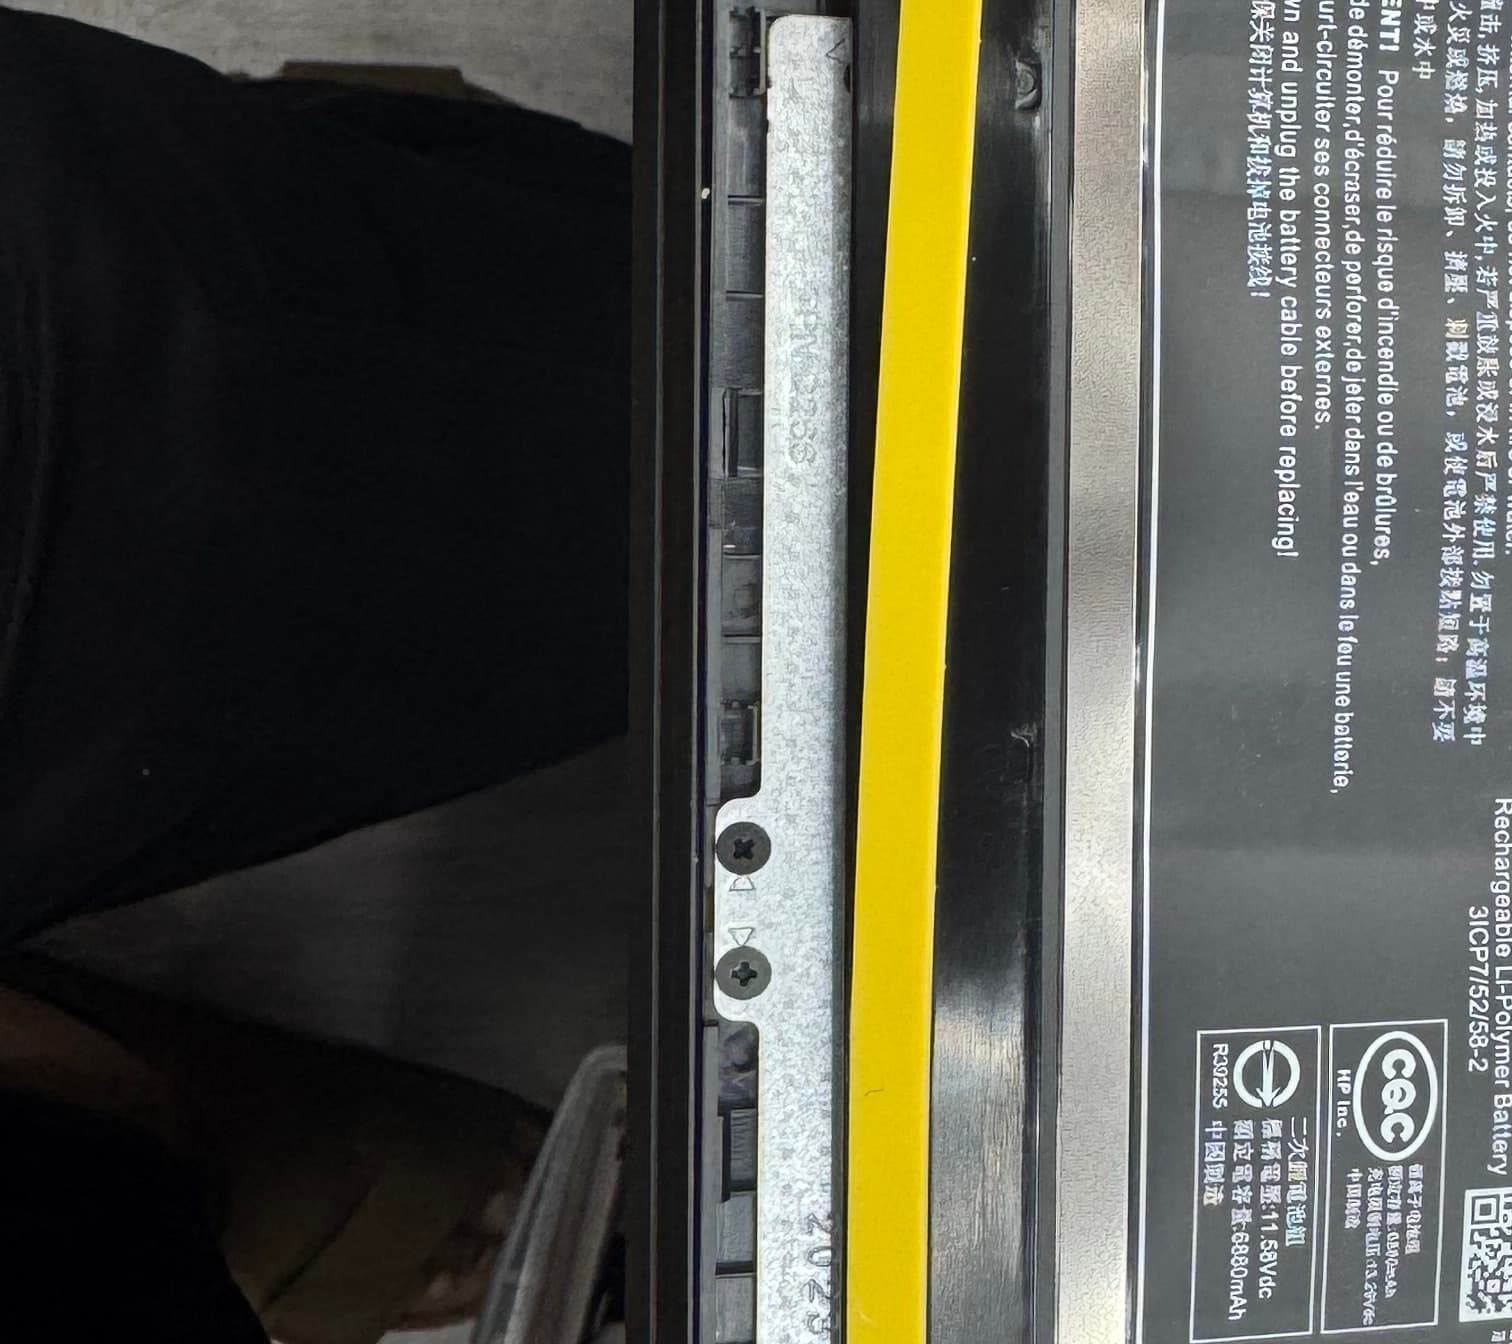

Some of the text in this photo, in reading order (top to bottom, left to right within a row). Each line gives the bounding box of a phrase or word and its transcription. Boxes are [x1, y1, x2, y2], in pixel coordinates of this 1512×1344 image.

[1281, 31, 1303, 72] and
[1274, 82, 1302, 157] unplug
[1279, 167, 1301, 200] the
[1275, 210, 1301, 288] battery
[1281, 296, 1303, 355] cable
[1280, 366, 1303, 436] before
[1272, 447, 1301, 557] replacing!
[1468, 906, 1489, 1072] 3ICP7/52/58-2
[1336, 1070, 1351, 1136] HP Inc.
[1381, 1049, 1416, 1143] CQC
